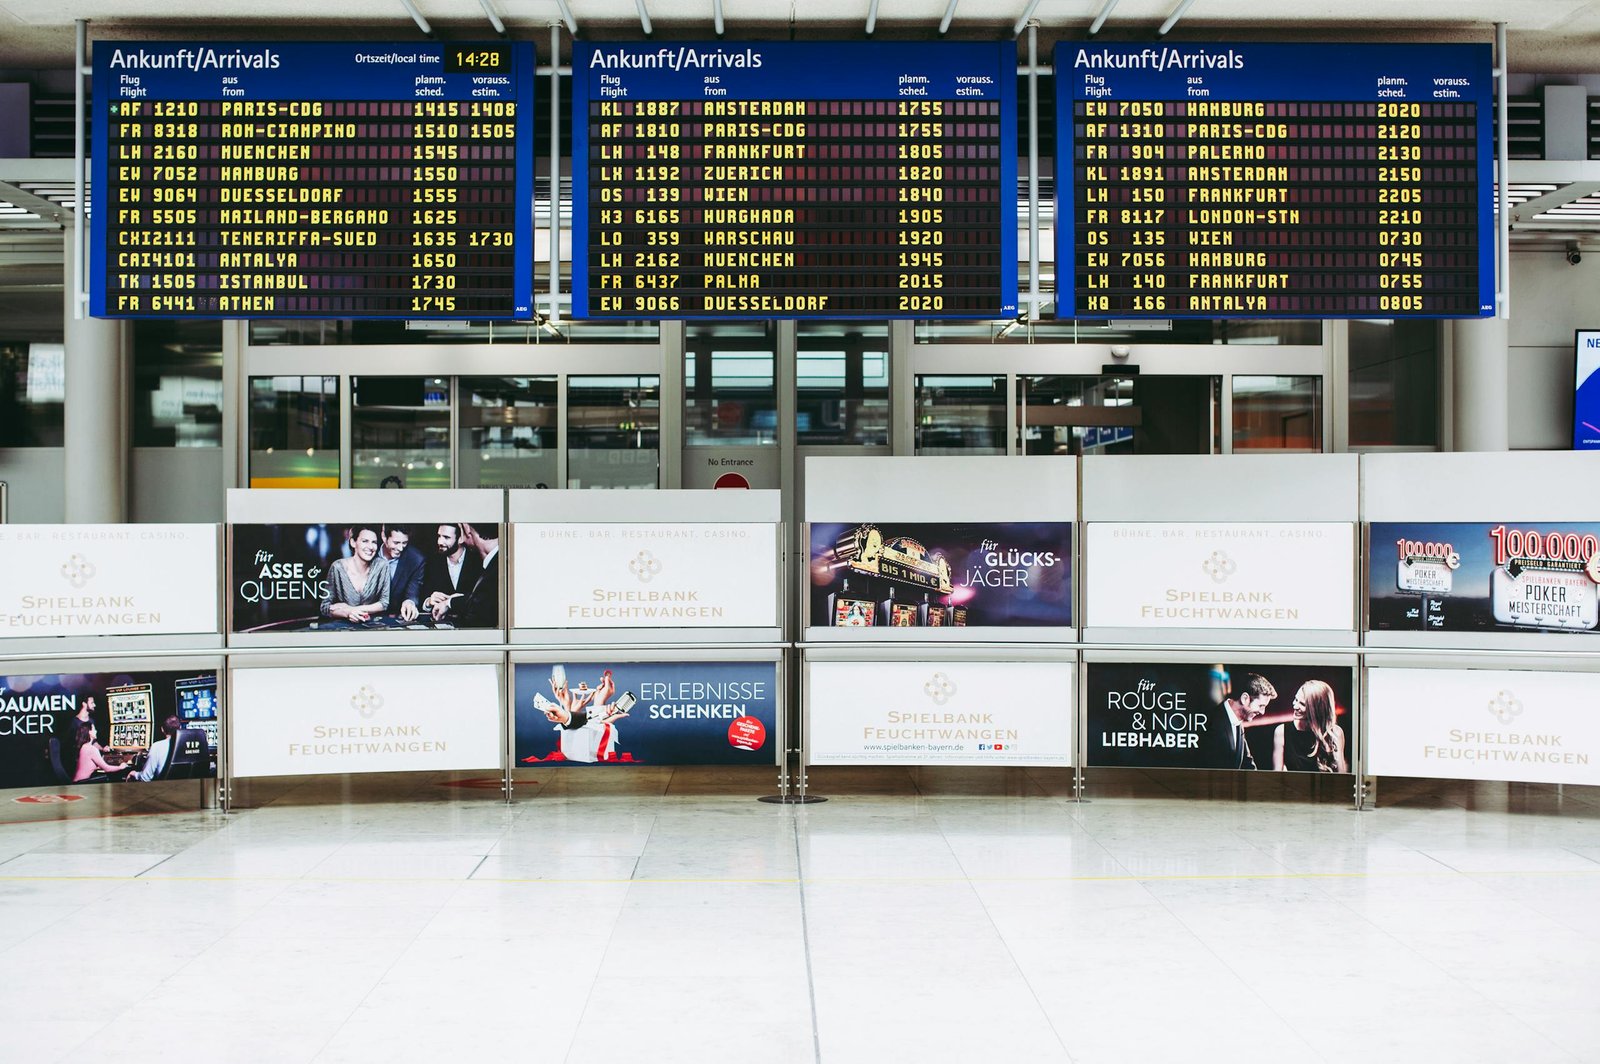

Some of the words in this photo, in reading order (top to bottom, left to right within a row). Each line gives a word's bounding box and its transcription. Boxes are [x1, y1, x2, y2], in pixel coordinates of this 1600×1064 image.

[110, 48, 280, 72] Ankunft/Arrivals
[355, 53, 416, 65] Ortszeit/local
[419, 53, 440, 64] time
[456, 52, 500, 67] 14:28
[590, 47, 761, 71] Ankunft/Arrivals
[1075, 48, 1244, 72] Ankunft/Arrivals
[120, 75, 140, 87] Flug
[222, 76, 239, 84] aus
[415, 75, 446, 87] planm.
[601, 75, 620, 87] Flug
[898, 75, 930, 86] planm.
[1085, 75, 1105, 87] Flug
[1187, 76, 1203, 84] aus
[1377, 76, 1408, 87] planm.
[1433, 78, 1470, 86] vorauss.
[120, 87, 147, 98] Flight
[222, 87, 245, 96] from
[415, 87, 444, 96] sched.
[472, 87, 500, 96] estim.
[601, 87, 627, 98] Flight
[704, 86, 727, 96] from
[898, 86, 928, 96] sched.
[956, 86, 984, 96] estim.
[1085, 87, 1112, 98] Flight
[1187, 87, 1210, 96] from
[1377, 88, 1406, 97] sched.
[1433, 89, 1460, 97] estim.
[120, 102, 140, 116] AF
[154, 102, 197, 116] 1210
[222, 101, 321, 116] PARIS-CDG
[414, 102, 457, 116] 1415
[471, 102, 514, 116] 1408
[601, 102, 622, 115] KL
[635, 101, 679, 115] 1887
[704, 101, 805, 115] AMSTERDAM
[899, 101, 942, 115] 1755
[1086, 102, 1106, 116] EW
[1119, 102, 1163, 116] 7050
[1187, 102, 1264, 116] HAMBURG
[1377, 103, 1419, 117] 2020
[120, 123, 140, 137] FR
[154, 123, 197, 137] 8318
[221, 123, 355, 137] ROM-CIAMPINO
[414, 123, 457, 137] 1510
[471, 123, 514, 137] 1505
[601, 123, 622, 137] AF
[635, 123, 679, 137] 1810
[704, 123, 805, 137] PARIS-CDG
[899, 123, 942, 137] 1755
[1086, 123, 1106, 137] AF
[1120, 123, 1163, 137] 1310
[1187, 123, 1286, 138] PARIS-CDG
[1378, 124, 1420, 138] 2120
[601, 145, 622, 159] LH
[647, 144, 679, 158] 148
[704, 144, 805, 158] FRANKFURT
[899, 144, 942, 158] 1805
[119, 188, 139, 202] EW
[153, 188, 196, 202] 9064
[220, 188, 342, 202] DUESSELDORF
[413, 188, 456, 202] 1555
[1087, 188, 1107, 201] LH
[1132, 188, 1164, 202] 150
[1188, 188, 1287, 202] FRANKFURT
[1378, 188, 1421, 202] 2205
[1087, 209, 1107, 223] FR
[1121, 209, 1164, 223] 8117
[1188, 209, 1299, 223] LONDON-STN
[1379, 210, 1421, 224] 2210
[118, 252, 193, 267] CAI4101
[219, 252, 296, 267] ANTALYA
[412, 253, 455, 267] 1650
[601, 253, 621, 267] LH
[635, 252, 679, 266] 2162
[704, 252, 793, 266] MUENCHEN
[899, 252, 942, 266] 1945
[118, 274, 138, 288] TK
[152, 274, 195, 288] 1505
[219, 274, 307, 288] ISTANBUL
[412, 275, 455, 289] 1730
[1088, 274, 1108, 288] LH
[1133, 274, 1164, 288] 140
[1189, 274, 1288, 288] FRANKFURT
[1379, 274, 1422, 288] 0755
[601, 296, 621, 310] EW
[635, 296, 679, 310] 9066
[704, 296, 828, 310] DUESSELDORF
[899, 295, 942, 310] 2020
[708, 458, 719, 467] No
[721, 458, 754, 467] Entrance
[980, 538, 998, 552] für
[254, 549, 273, 565] für
[985, 548, 1061, 567] GLÜCKS-
[1514, 559, 1543, 567] PREISGELD
[1546, 561, 1582, 569] GARANTIERT
[259, 563, 304, 579] ASSE
[881, 563, 899, 576] BIS
[902, 569, 907, 578] 1
[909, 573, 929, 585] MIO.
[930, 578, 938, 587] €
[960, 565, 1028, 587] JÄGER
[1414, 569, 1437, 579] POKER
[239, 580, 331, 603] QUEENS
[592, 588, 698, 602] SPIELBANK
[1166, 588, 1273, 603] SPIELBANK
[1525, 584, 1567, 603] POKER
[21, 595, 135, 609] SPIELBANK
[1508, 601, 1582, 618] MEISTERSCHAFT
[568, 604, 724, 618] FEUCHTWANGEN
[1141, 605, 1299, 620] FEUCHTWANGEN
[640, 682, 766, 701] ERLEBNISSE
[1137, 678, 1155, 692] für
[1108, 692, 1187, 710] ROUGE
[649, 704, 746, 719] SCHENKEN
[887, 710, 993, 724] SPIELBANK
[1132, 712, 1146, 731] &
[1152, 713, 1207, 732] NOIR
[313, 725, 421, 739] SPIELBANK
[863, 727, 1018, 741] FEUCHTWANGEN
[1449, 729, 1562, 746] SPIELBANK
[185, 741, 200, 749] VIP
[288, 740, 447, 756] FEUCHTWANGEN
[863, 743, 964, 752] www.spielbanken-bayern.de
[1102, 732, 1200, 749] LIEBHABER
[1424, 745, 1589, 765] FEUCHTWANGEN
